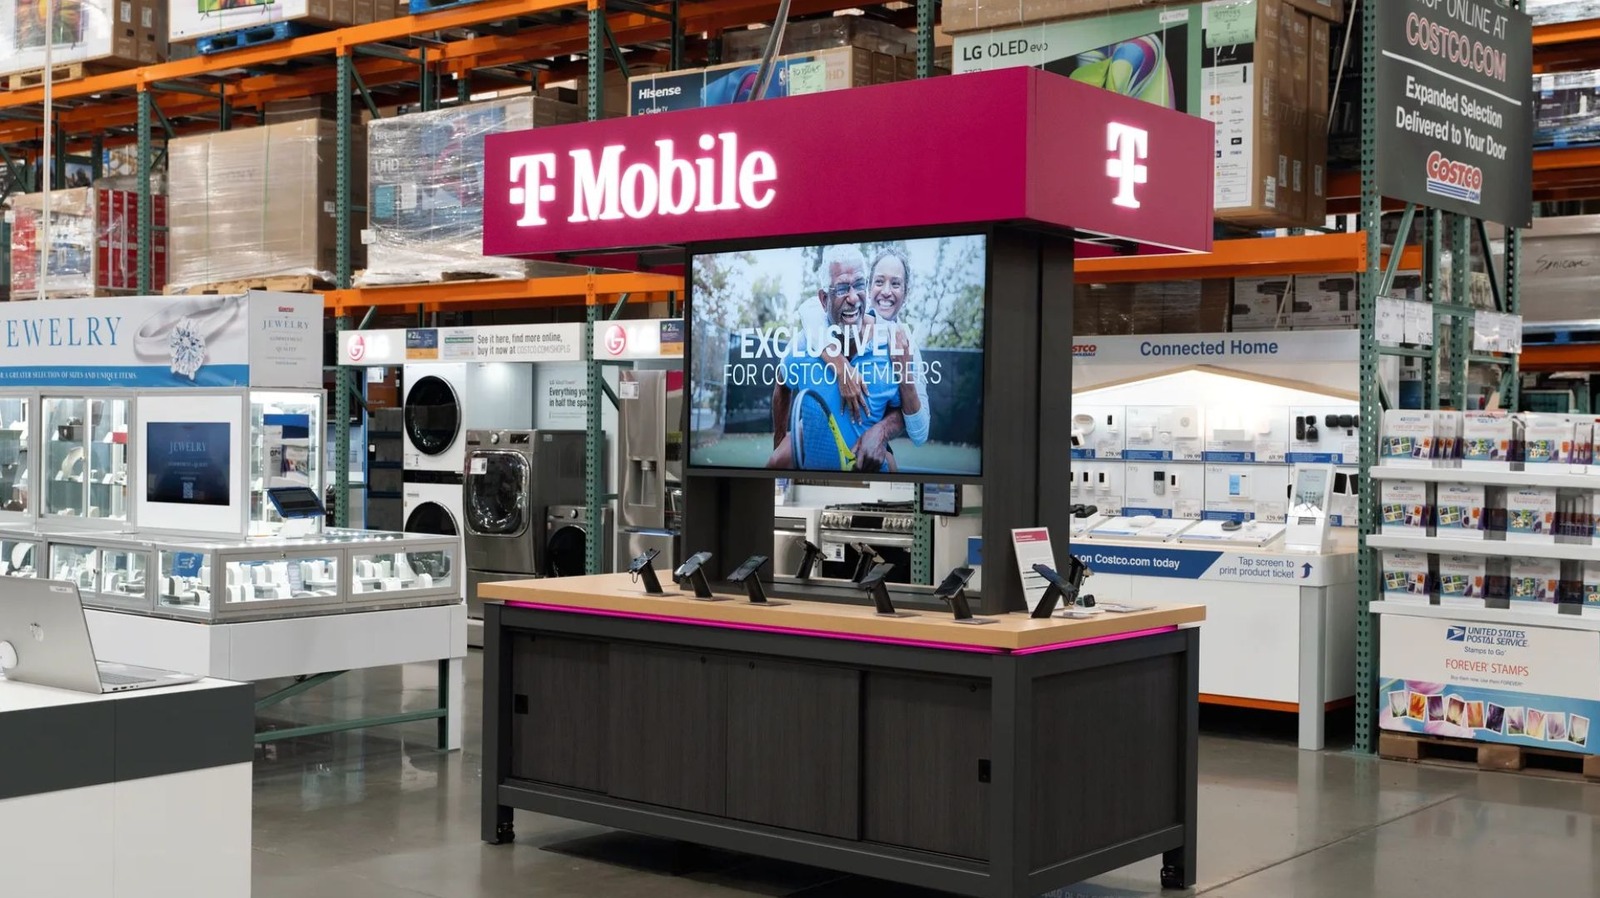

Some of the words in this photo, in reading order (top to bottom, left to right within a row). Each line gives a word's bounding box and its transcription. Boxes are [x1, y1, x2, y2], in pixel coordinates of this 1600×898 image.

[1447, 0, 1492, 34] ONLINE
[1493, 14, 1508, 40] AT
[963, 45, 982, 61] LG
[988, 39, 1029, 58] OLED
[1029, 42, 1049, 53] evo
[1406, 11, 1507, 82] COSTCO.COM
[638, 86, 682, 100] Hisense
[1405, 75, 1459, 114] Expanded
[1460, 95, 1503, 129] Selection
[1396, 105, 1449, 141] Delivered
[1451, 123, 1462, 145] to
[1464, 127, 1486, 152] Your
[1486, 134, 1508, 160] Door
[509, 152, 557, 227] T
[567, 131, 778, 223] Mobile
[0, 316, 122, 348] EWELRY
[262, 320, 310, 330] JEWELRY
[477, 334, 488, 344] See
[490, 334, 495, 343] it
[496, 334, 511, 345] here,
[512, 333, 523, 343] find
[525, 335, 540, 343] more
[542, 332, 563, 343] online,
[741, 323, 921, 359] EXCLUSIVELY
[477, 346, 488, 357] buy
[490, 346, 495, 355] it
[496, 347, 508, 355] now
[509, 346, 516, 355] at
[1140, 340, 1225, 357] Connected
[1230, 339, 1279, 355] Home
[723, 363, 758, 386] FOR
[762, 362, 838, 386] COSTCO
[843, 360, 942, 385] MEMBERS
[549, 387, 578, 398] Everything
[549, 399, 555, 407] in
[555, 399, 566, 407] half
[567, 399, 576, 407] the
[576, 400, 588, 408] spa
[168, 441, 207, 455] JEWELRY
[1080, 554, 1093, 563] on
[1094, 553, 1151, 566] Costco.com
[1152, 557, 1181, 571] today
[1238, 556, 1254, 567] Tap
[1255, 559, 1284, 568] screen
[1286, 560, 1295, 568] to
[1219, 566, 1238, 576] print
[1239, 568, 1271, 578] product
[1272, 569, 1295, 579] ticket
[1466, 635, 1495, 645] POSTAL
[1468, 626, 1498, 637] UNITED
[1498, 629, 1526, 639] STATES
[1464, 646, 1487, 655] Stamps
[1445, 658, 1488, 673] FOREVER
[1491, 663, 1530, 677] STAMPS
